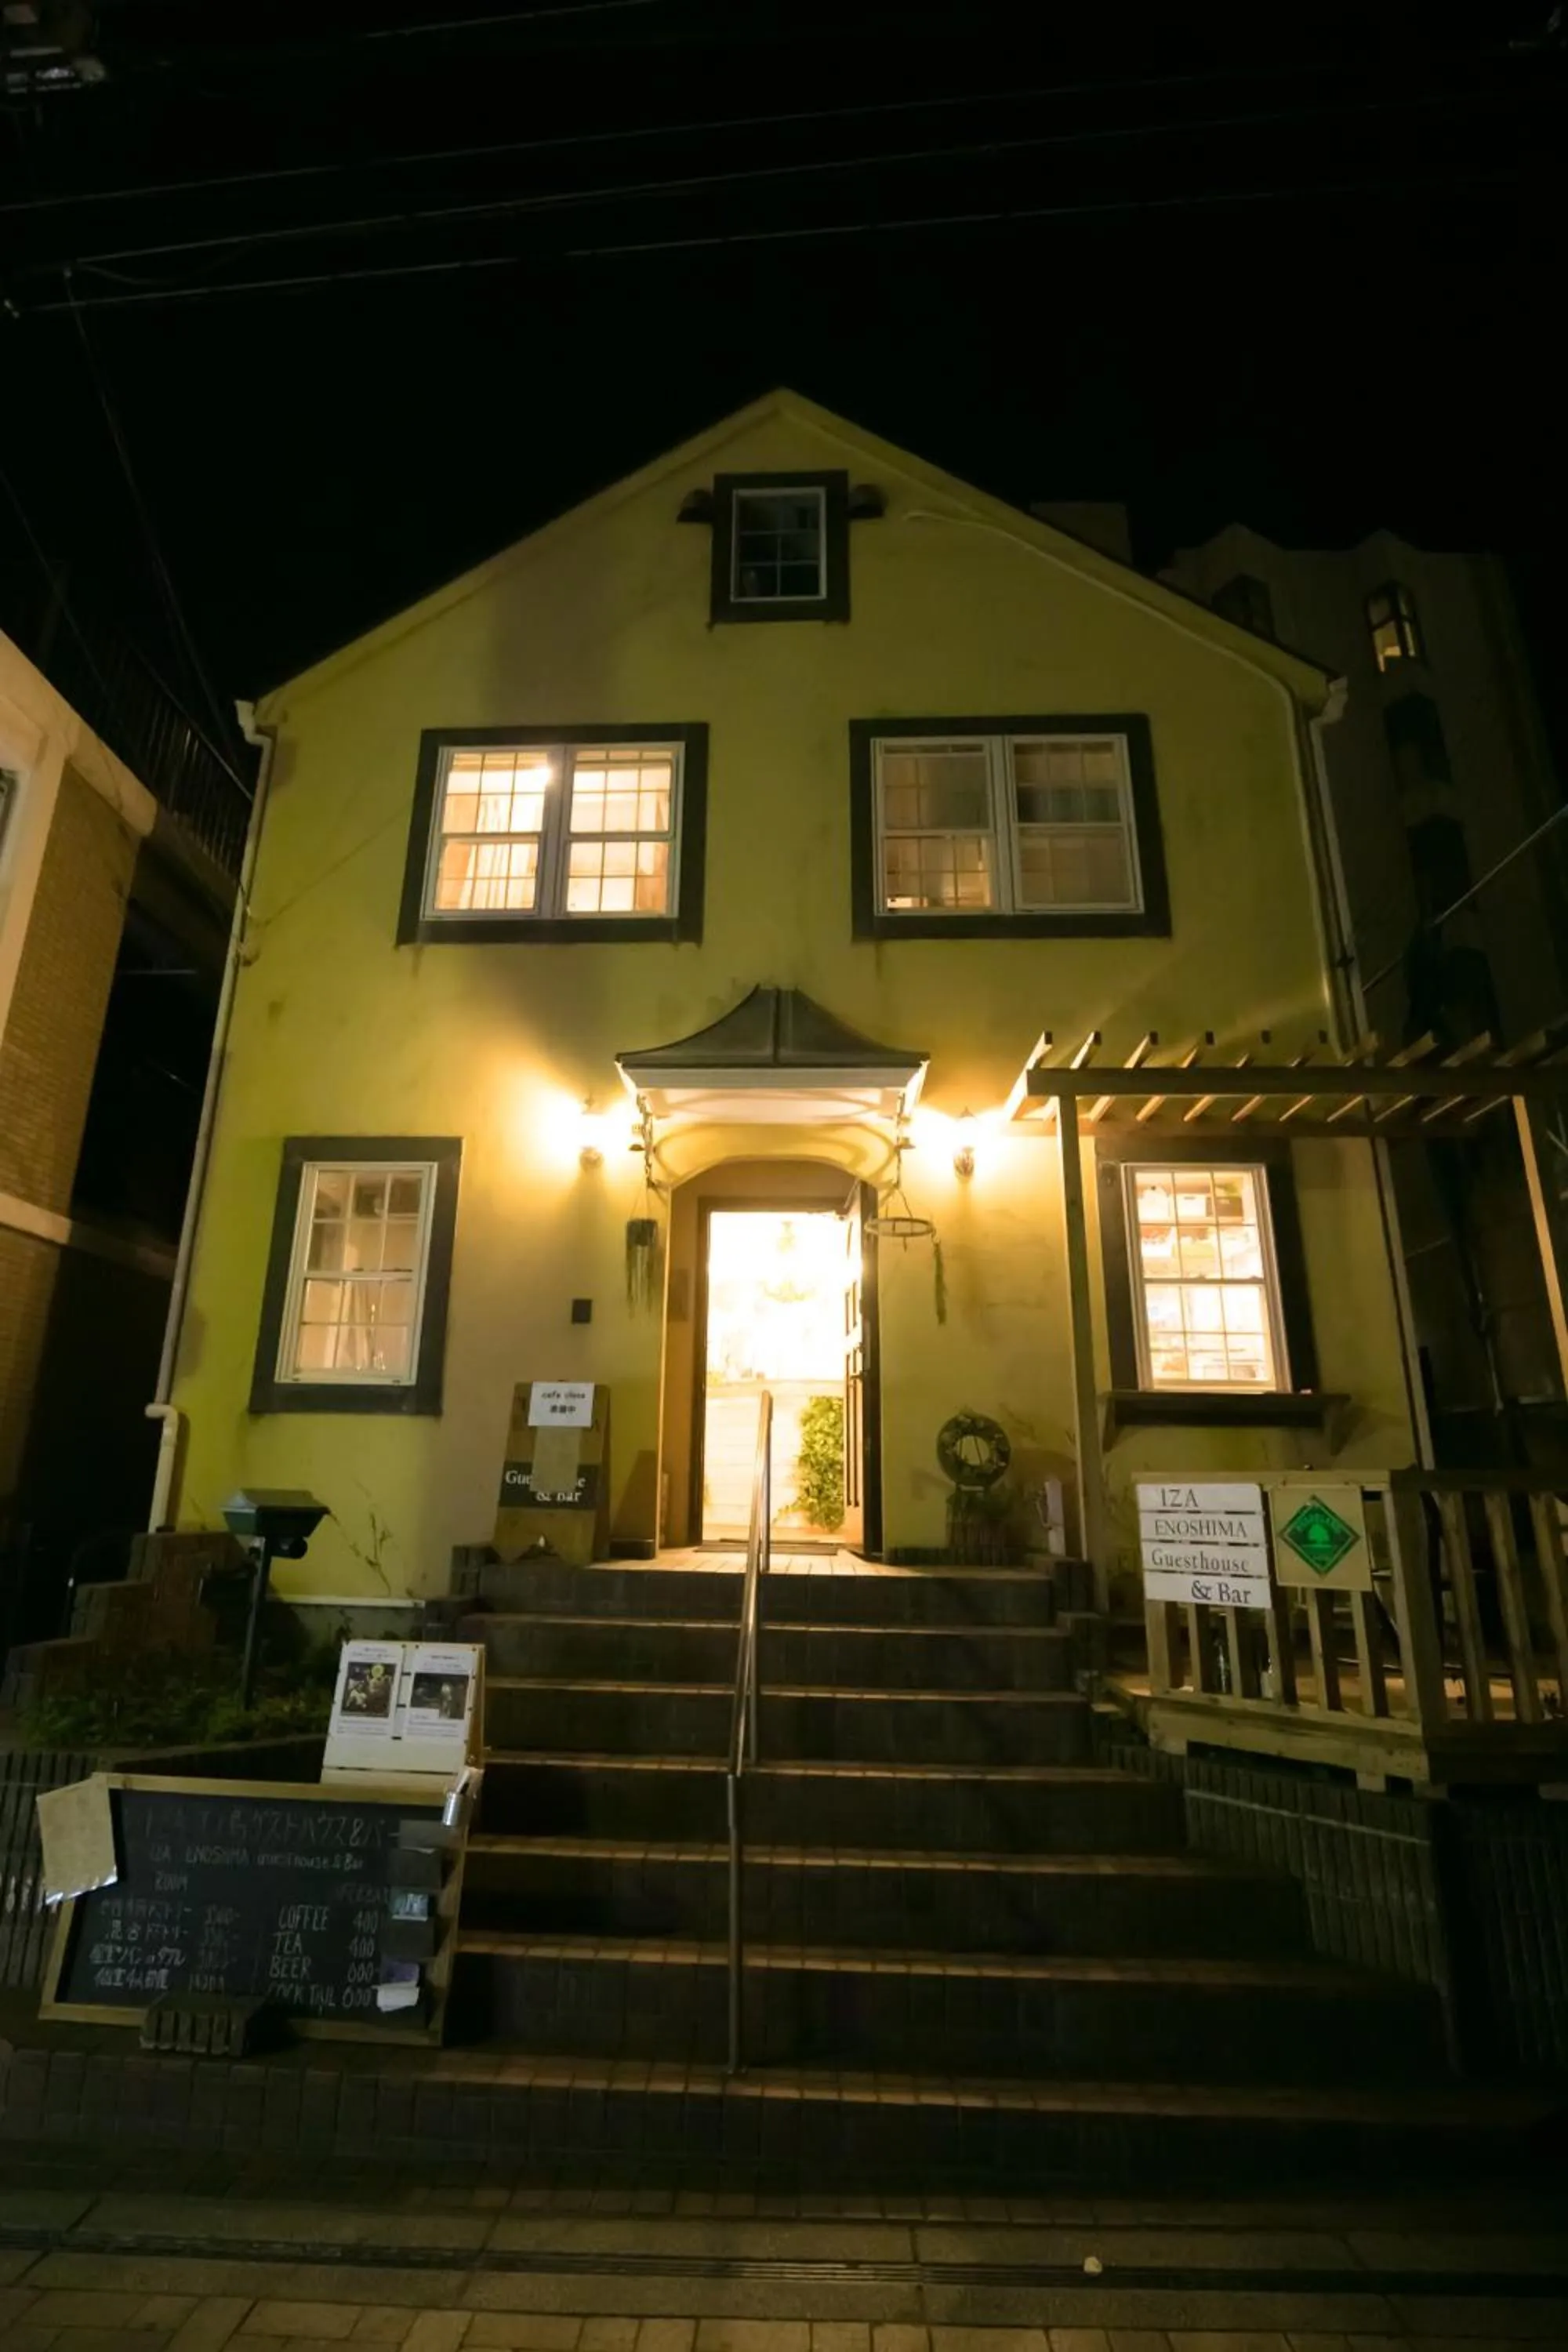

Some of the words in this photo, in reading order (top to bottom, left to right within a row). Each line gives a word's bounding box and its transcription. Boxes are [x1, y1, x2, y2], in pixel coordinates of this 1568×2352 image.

[1160, 1488, 1200, 1508] IZA
[1154, 1519, 1248, 1539] ENOSHIMA
[1151, 1543, 1249, 1573] Guesthouse
[1191, 1580, 1213, 1601] &
[1217, 1582, 1252, 1604] Bar
[278, 1904, 330, 1931] COFFEE
[272, 1931, 303, 1955] TEA
[268, 1955, 312, 1980] BEER
